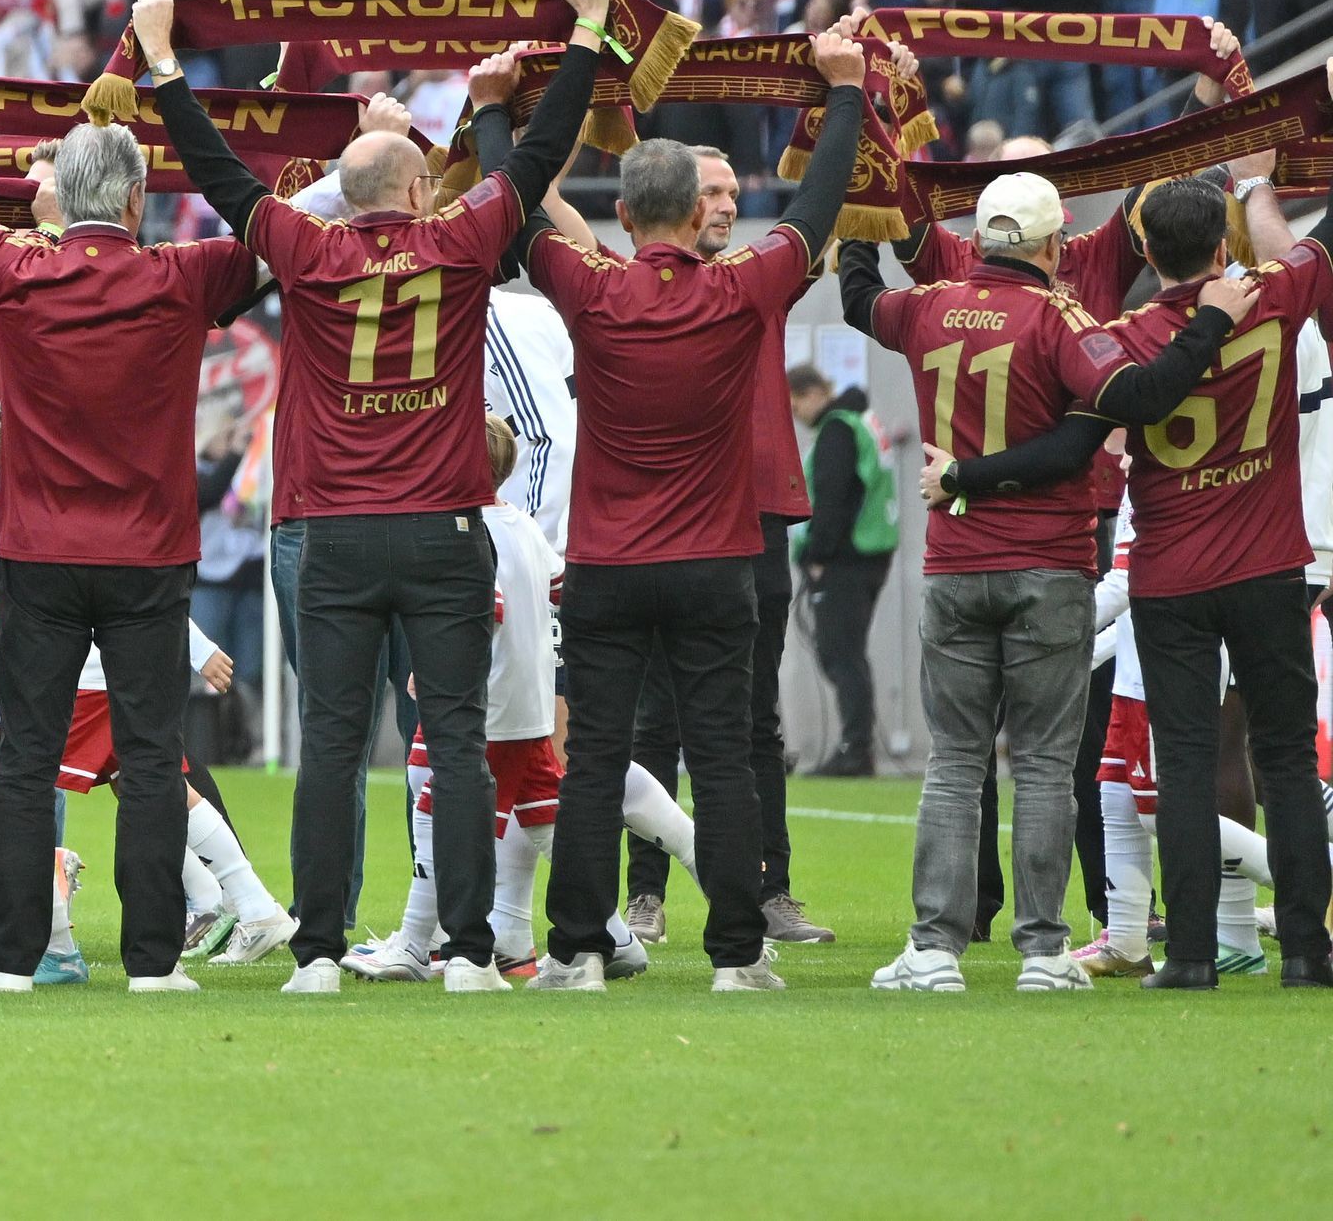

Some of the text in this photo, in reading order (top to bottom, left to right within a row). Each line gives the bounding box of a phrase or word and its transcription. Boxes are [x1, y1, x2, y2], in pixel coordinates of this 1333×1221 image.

[904, 10, 992, 40] FC
[362, 252, 418, 274] MARC
[338, 267, 442, 383] 11
[942, 308, 1008, 331] GEORG
[343, 385, 448, 414] 1. FC KÖLN
[922, 339, 1016, 458] 11
[1144, 318, 1283, 469] 67
[1198, 467, 1225, 491] FC
